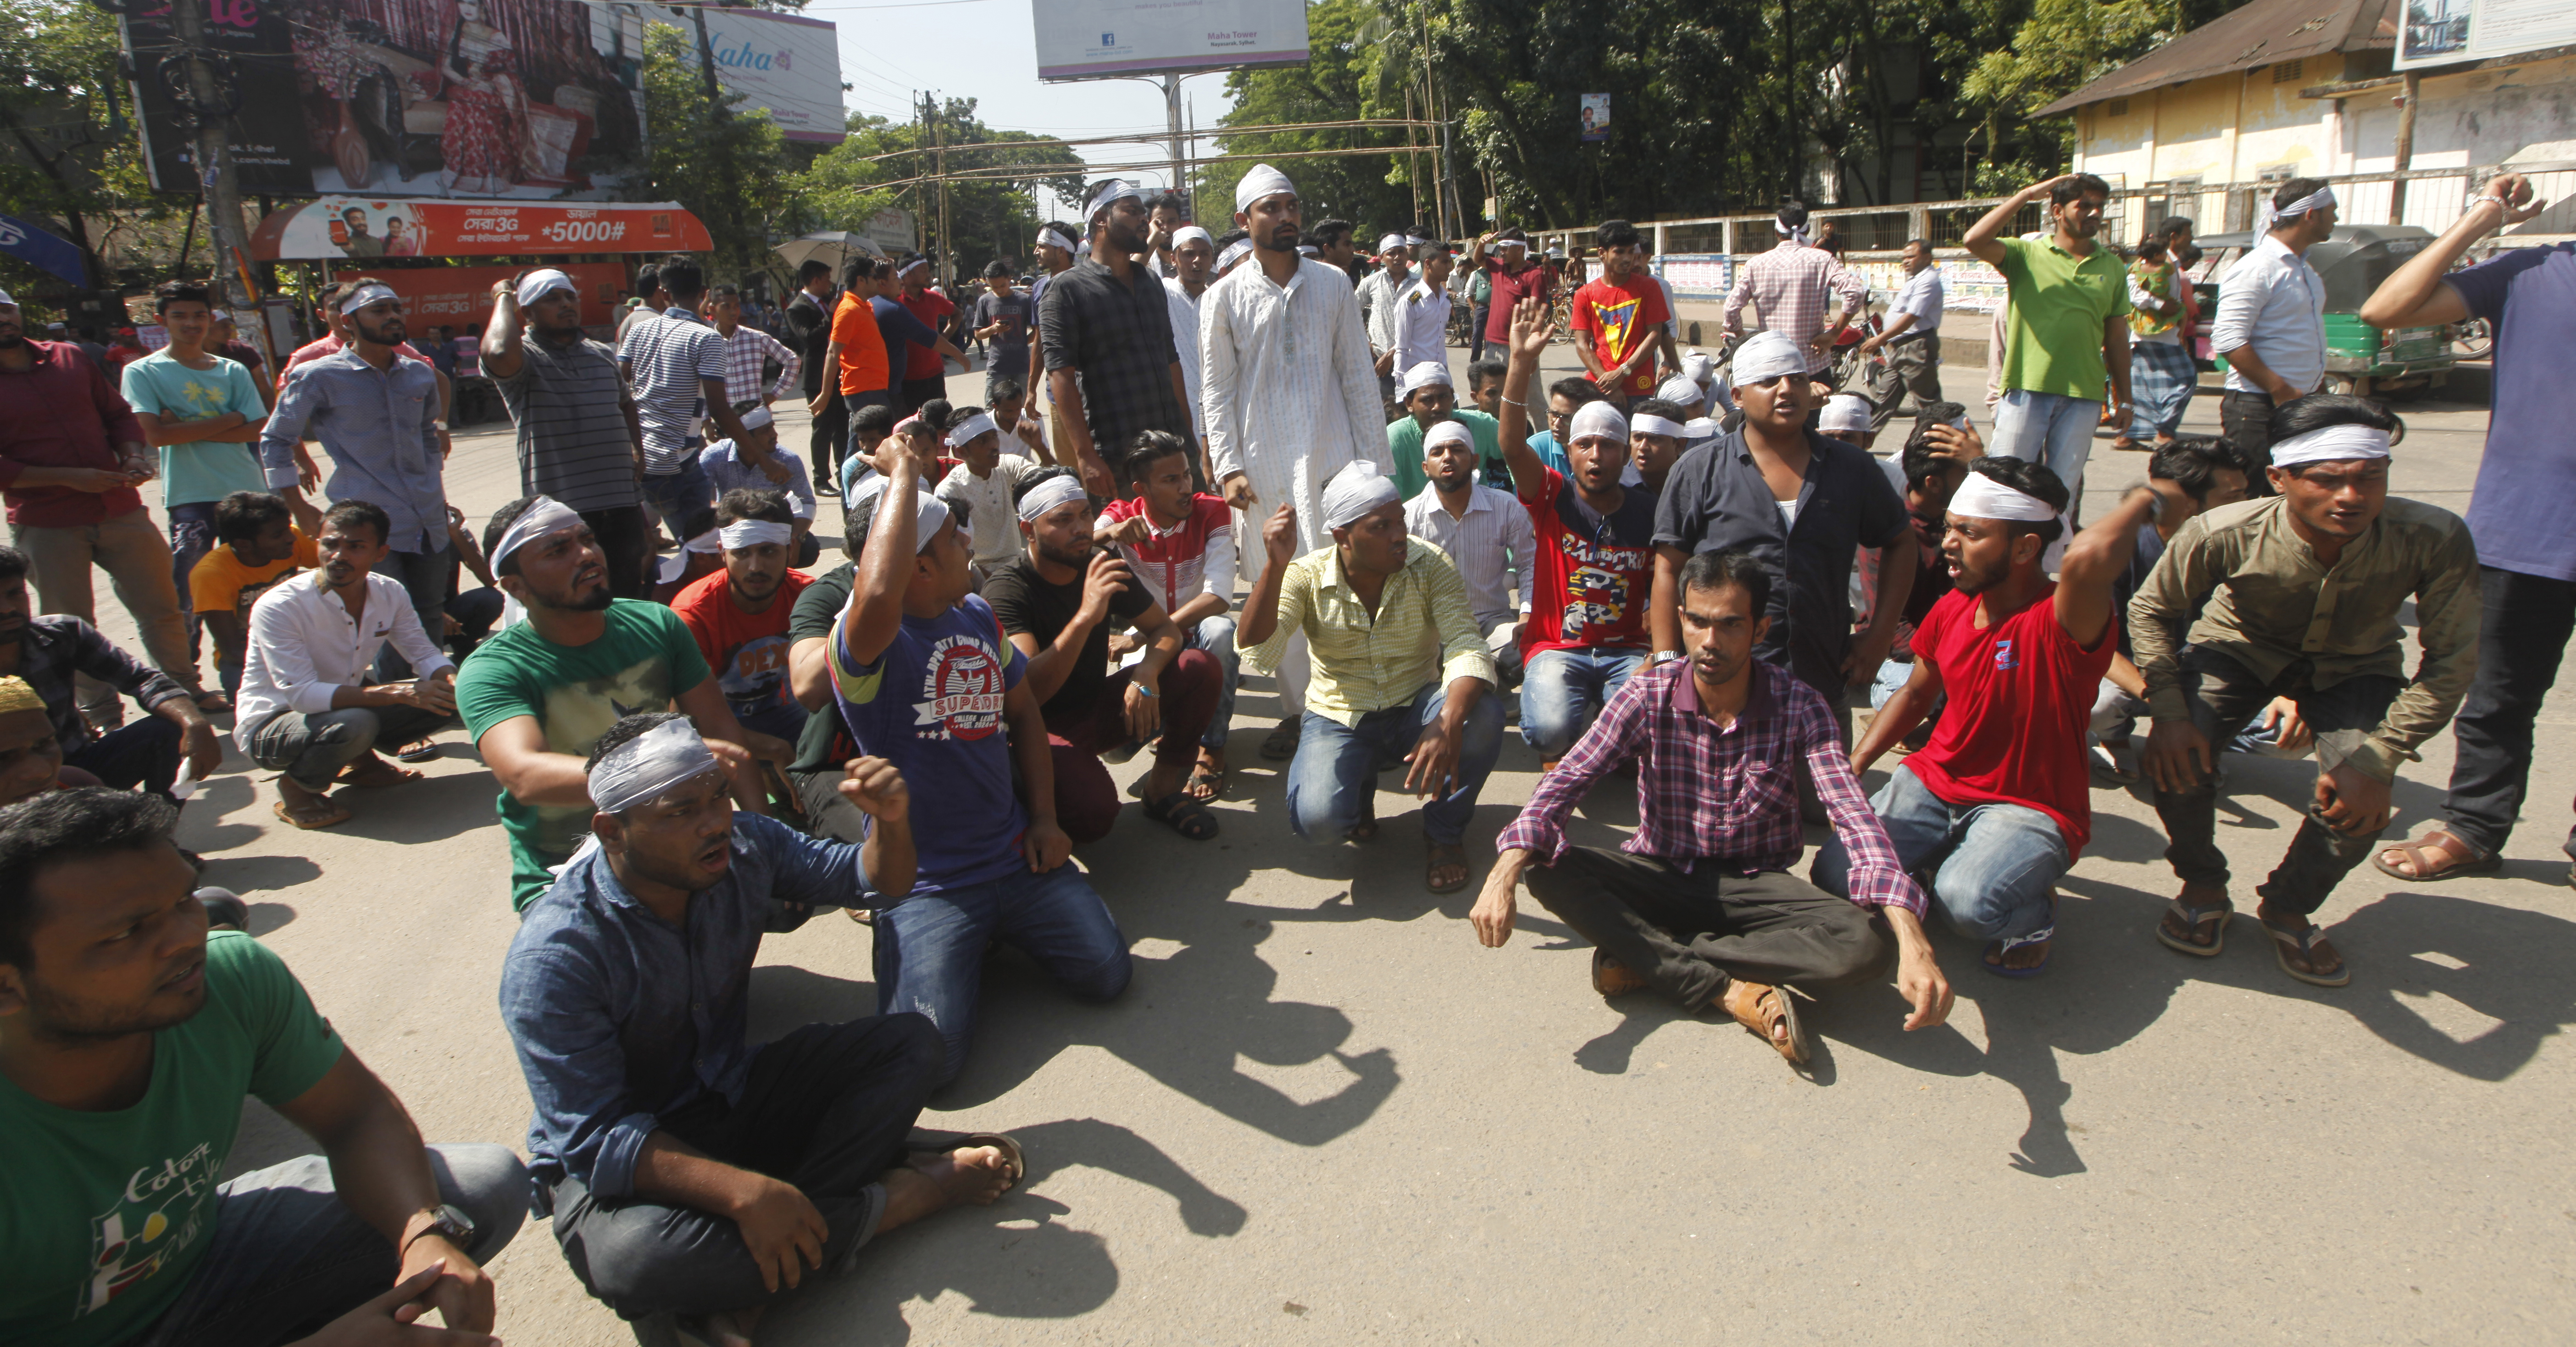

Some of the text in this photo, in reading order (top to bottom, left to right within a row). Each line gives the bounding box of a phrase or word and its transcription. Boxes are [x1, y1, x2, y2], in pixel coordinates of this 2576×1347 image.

[464, 217, 519, 232] সেরা 3G
[449, 301, 469, 314] 3G
